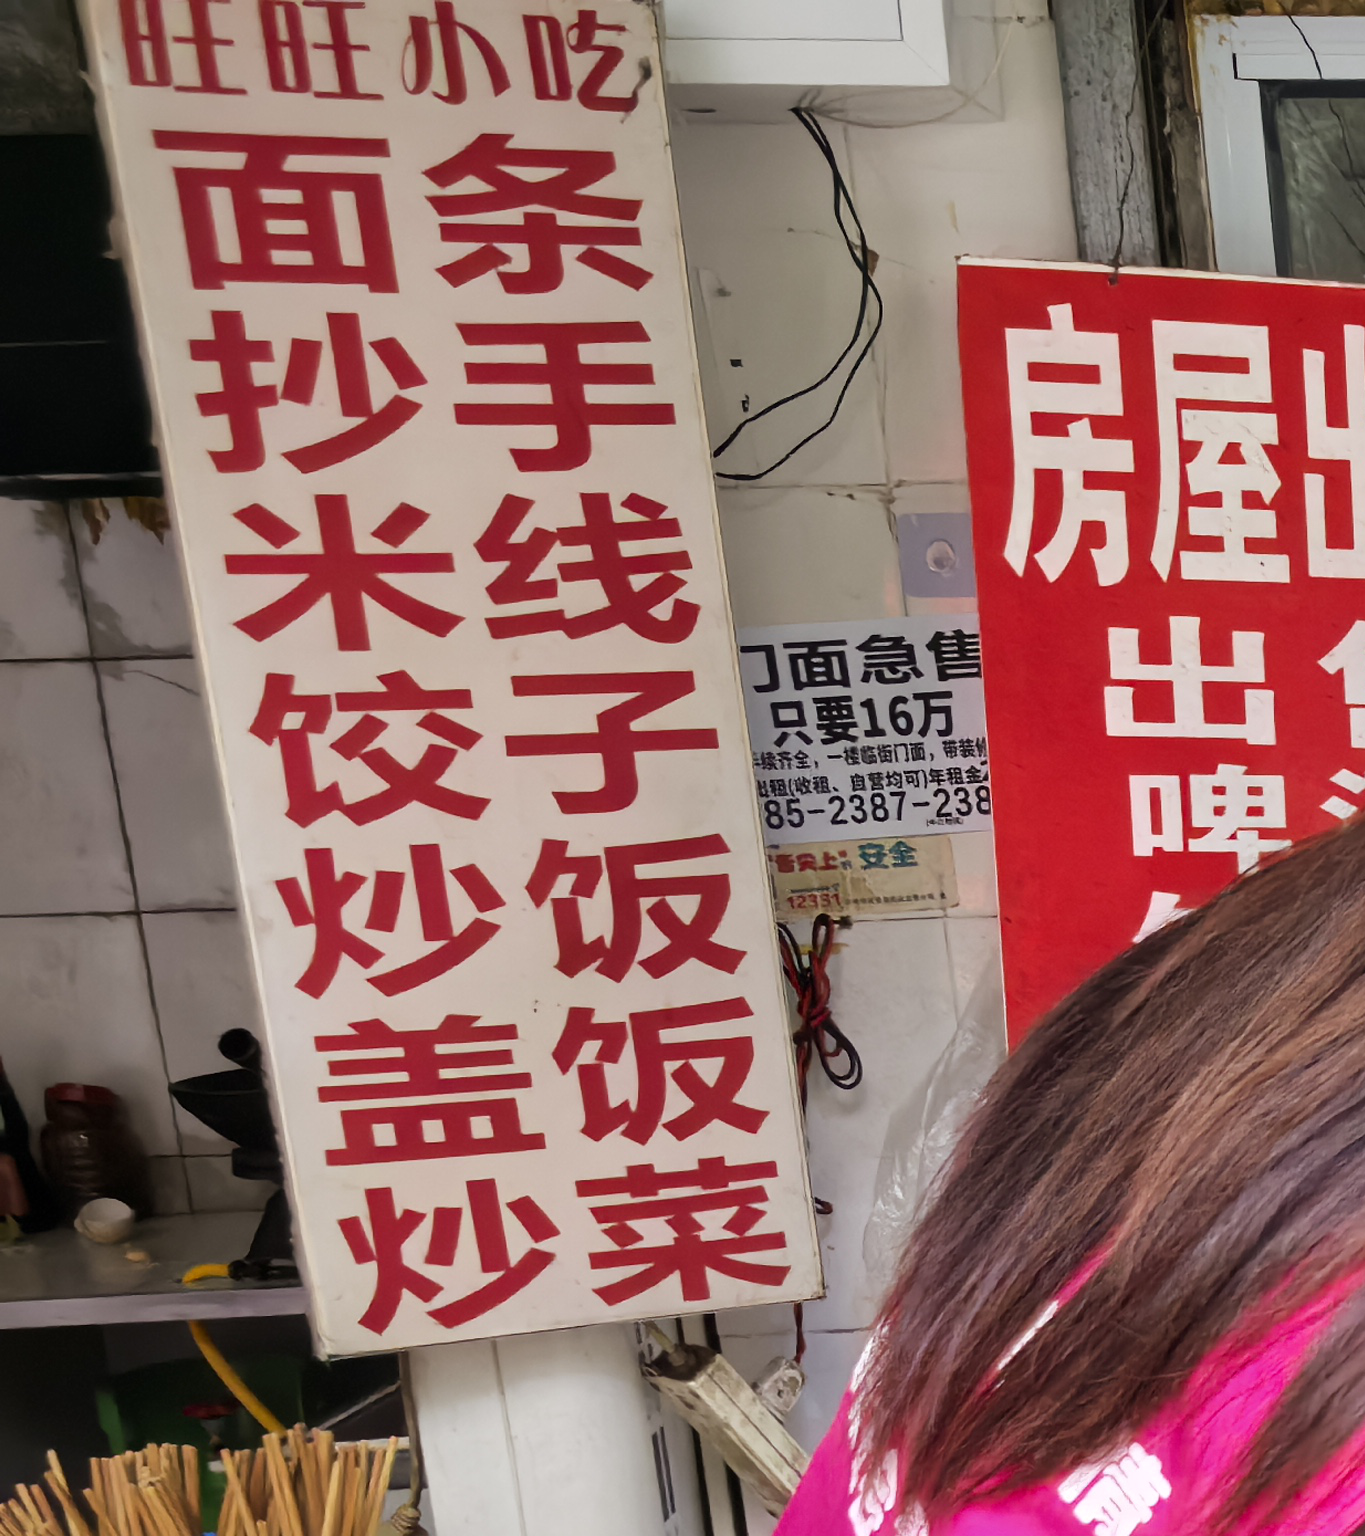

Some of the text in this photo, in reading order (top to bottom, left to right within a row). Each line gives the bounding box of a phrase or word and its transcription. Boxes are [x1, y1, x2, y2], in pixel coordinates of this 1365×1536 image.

[121, 0, 640, 113] 旺旺小吃
[154, 131, 653, 294] 面条
[190, 311, 675, 474] 抄手
[224, 493, 701, 651] 米线
[250, 670, 719, 828] 饺子
[769, 690, 953, 748] 只要16万
[275, 834, 748, 1000] 炒饭
[314, 996, 769, 1166] 盖饭
[338, 1157, 790, 1334] 炒菜
